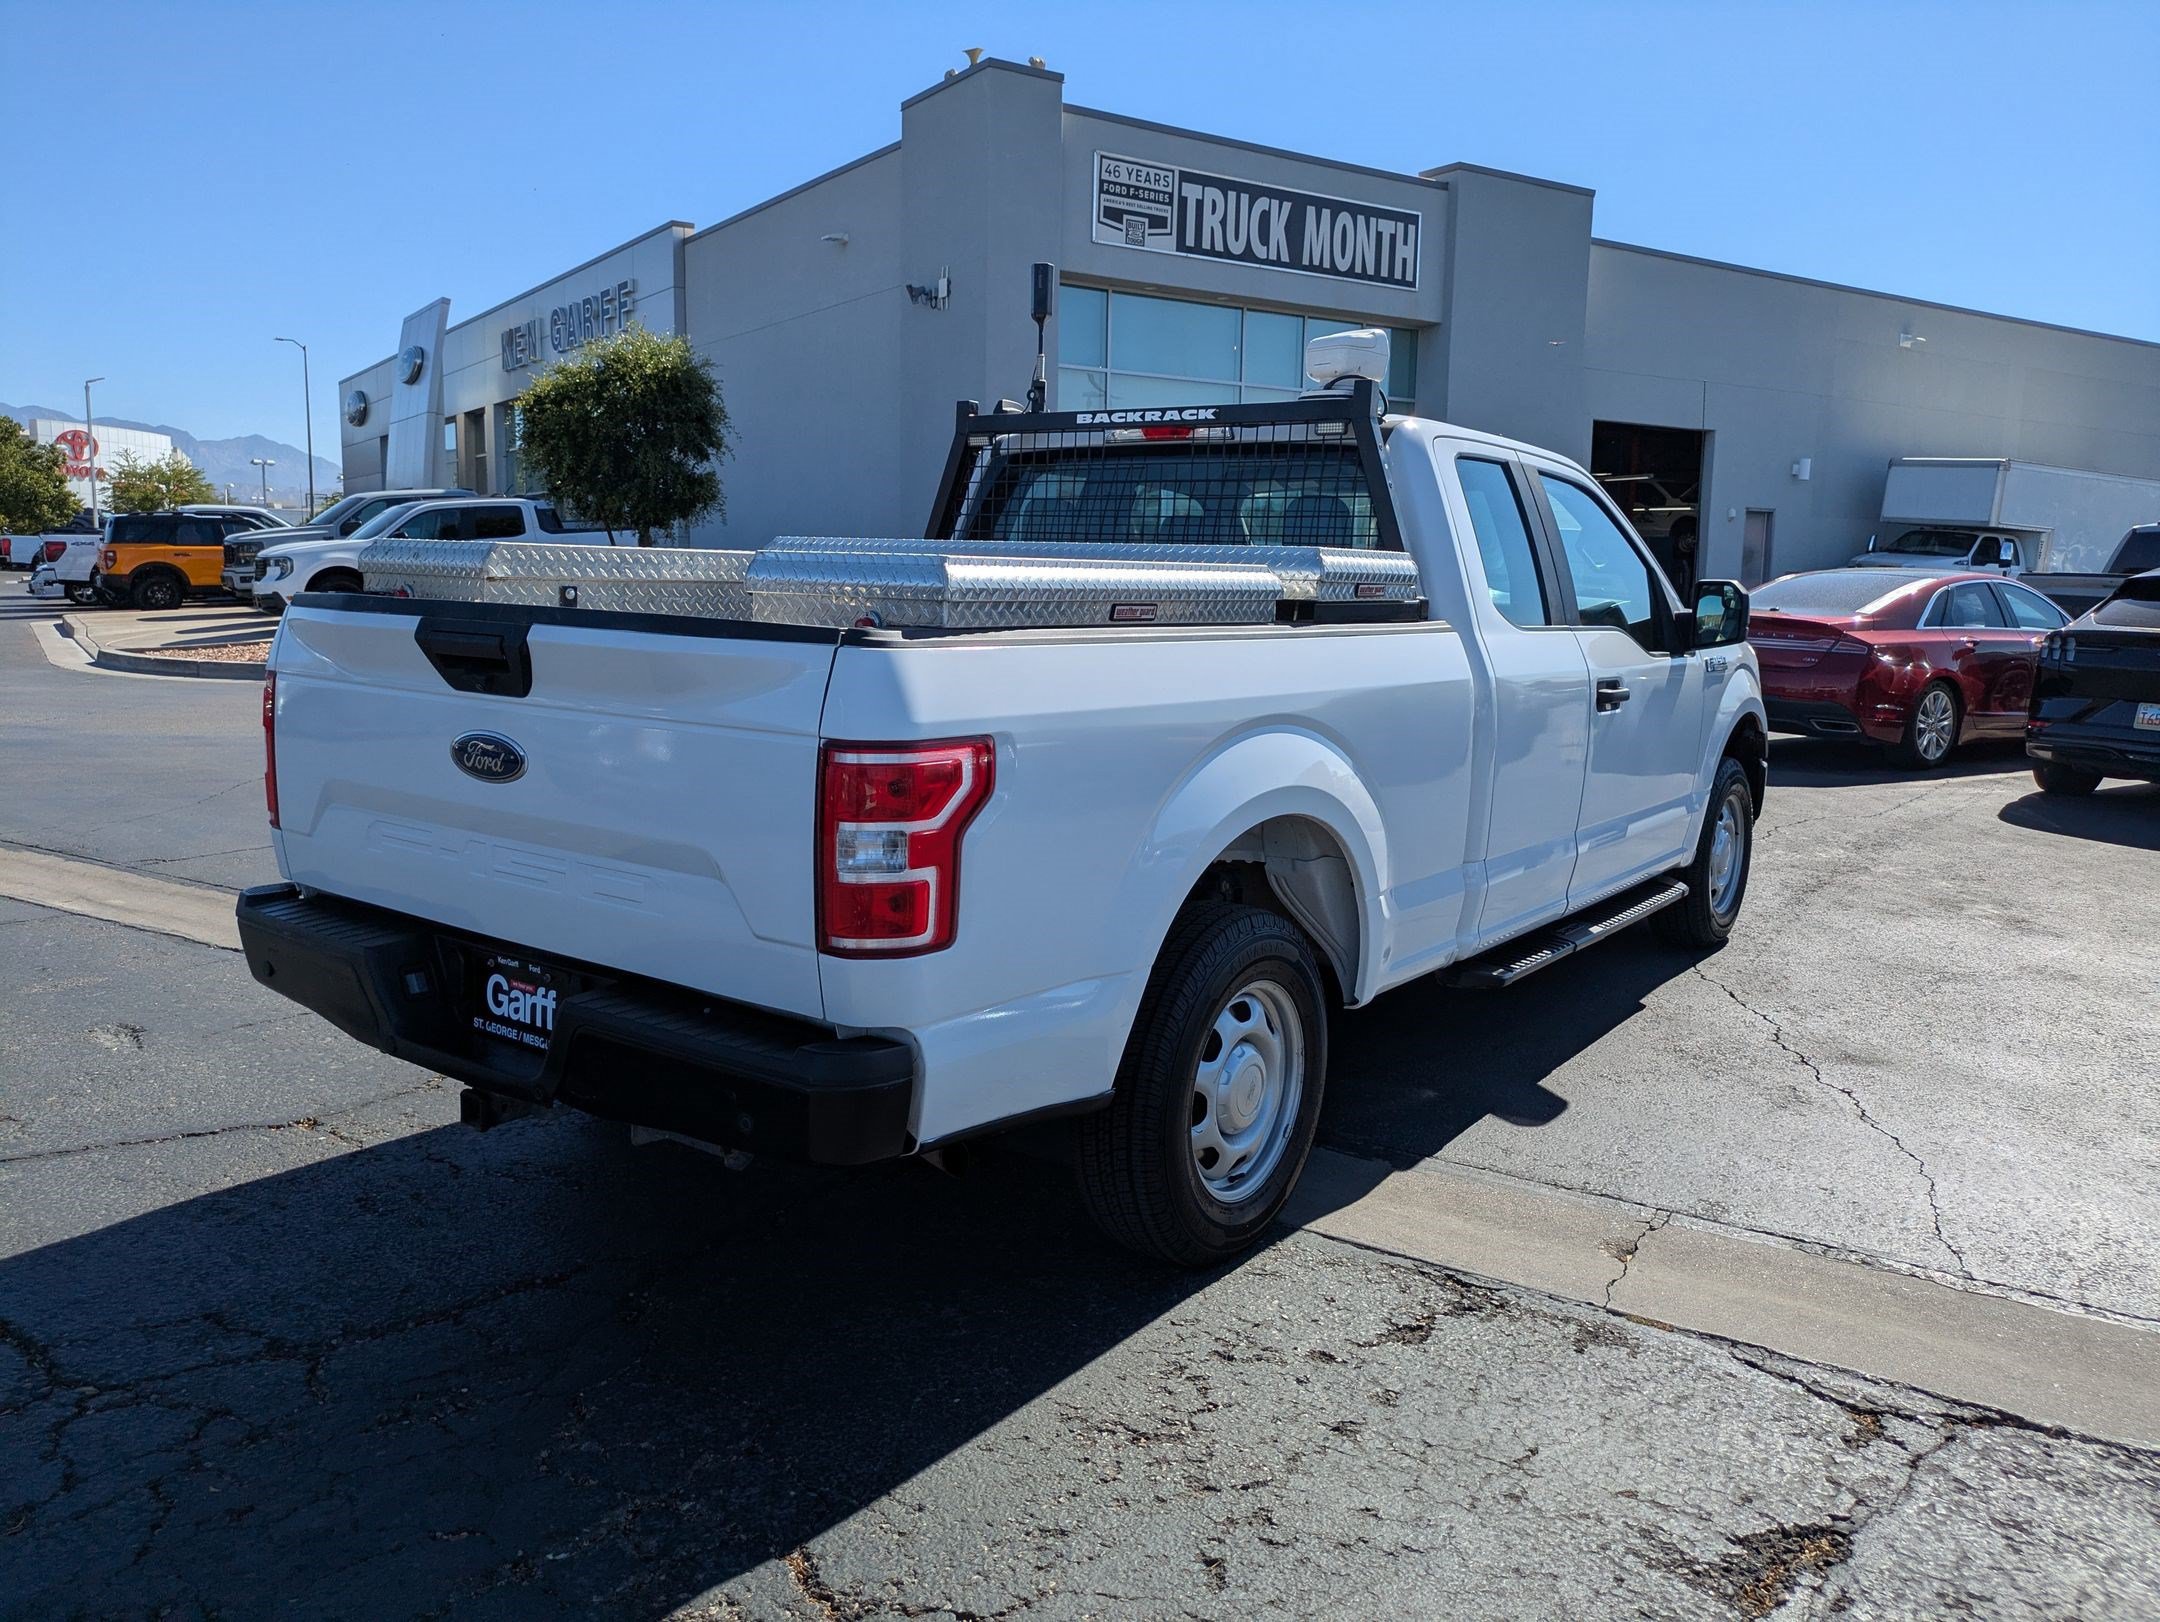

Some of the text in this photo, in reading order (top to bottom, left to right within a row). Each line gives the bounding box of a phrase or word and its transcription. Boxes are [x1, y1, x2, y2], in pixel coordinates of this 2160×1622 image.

[1104, 163, 1170, 188] 46 YEARS
[1103, 183, 1170, 203] FORD F-SERIES
[1127, 221, 1144, 231] BUILT
[1180, 182, 1416, 282] TRUCK MONTH
[501, 278, 635, 371] KEN GARFF
[1076, 408, 1217, 424] BACKRACK
[463, 740, 505, 772] Ford
[528, 964, 541, 974] Ford
[486, 973, 557, 1030] Garff
[473, 1017, 485, 1030] ST.
[486, 1021, 518, 1039] GEORGE
